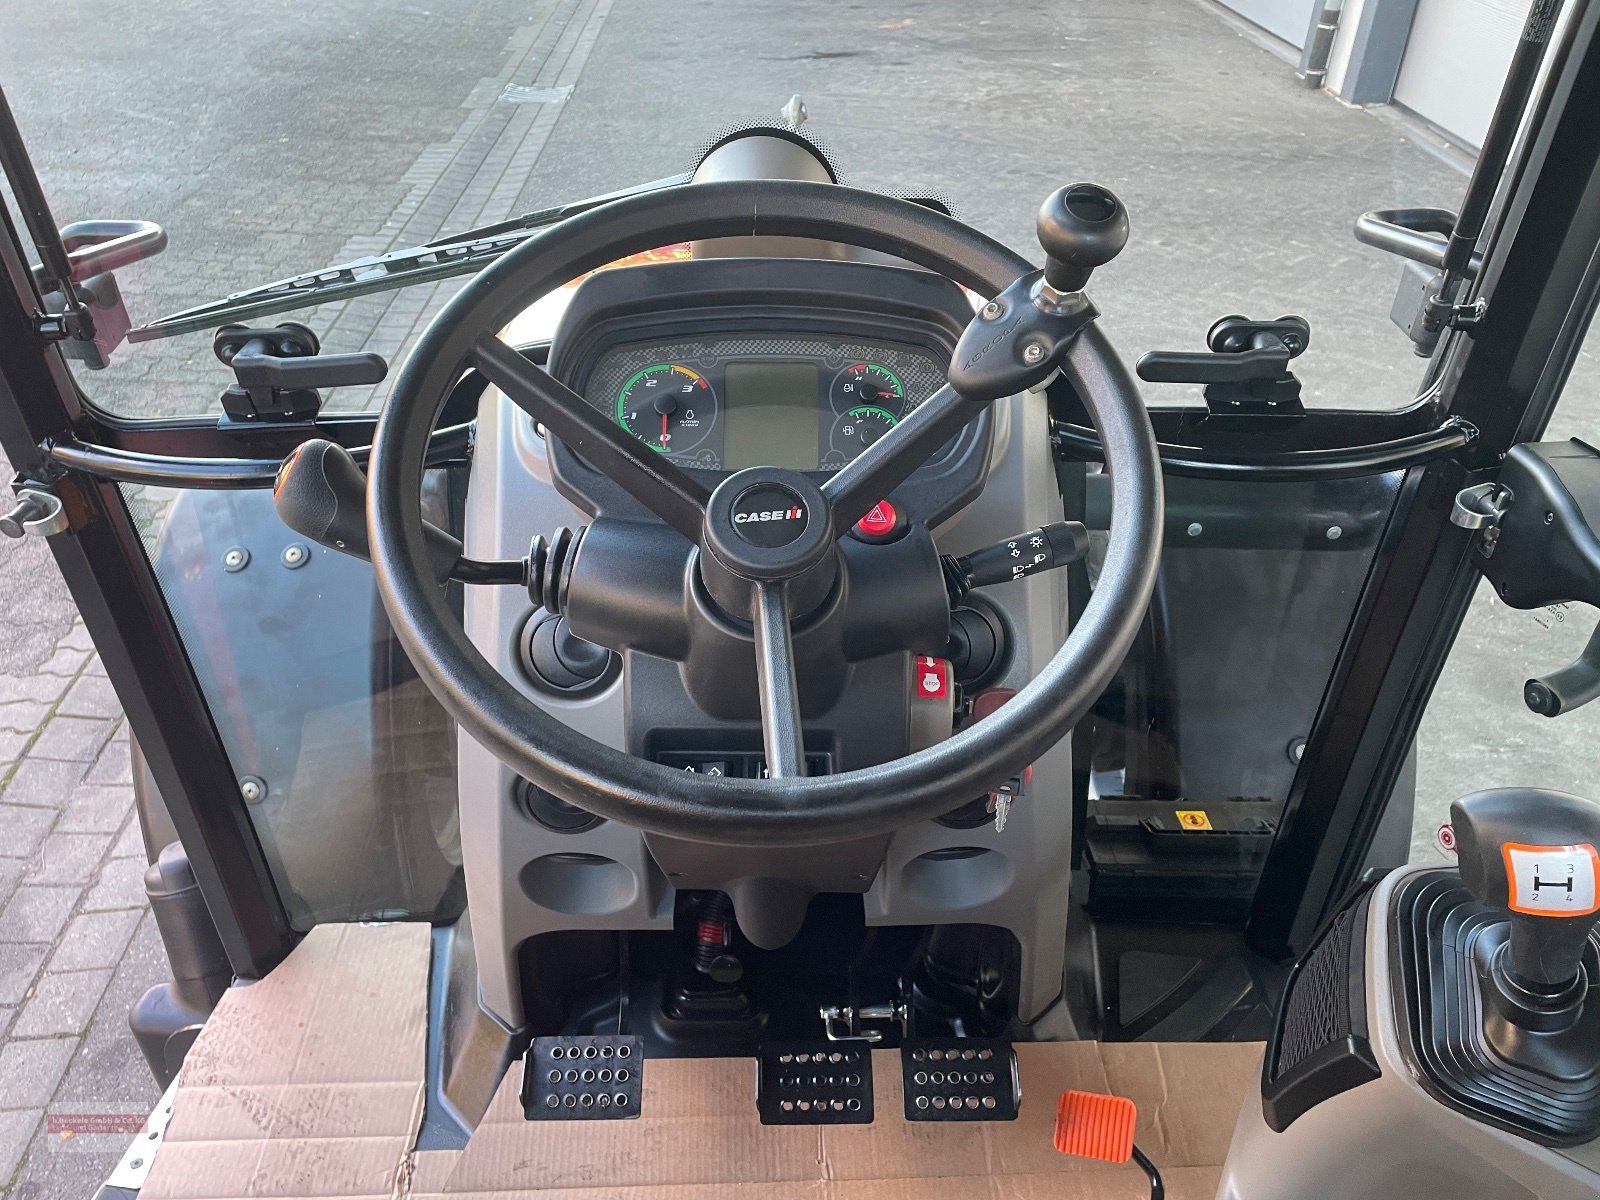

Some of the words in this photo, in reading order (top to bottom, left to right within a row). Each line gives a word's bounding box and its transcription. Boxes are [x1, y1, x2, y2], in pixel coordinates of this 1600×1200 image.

[734, 510, 784, 524] CASE
[1534, 864, 1539, 873] 1
[1567, 864, 1575, 874] 3
[1532, 893, 1539, 902] 2
[1565, 894, 1573, 902] 4
